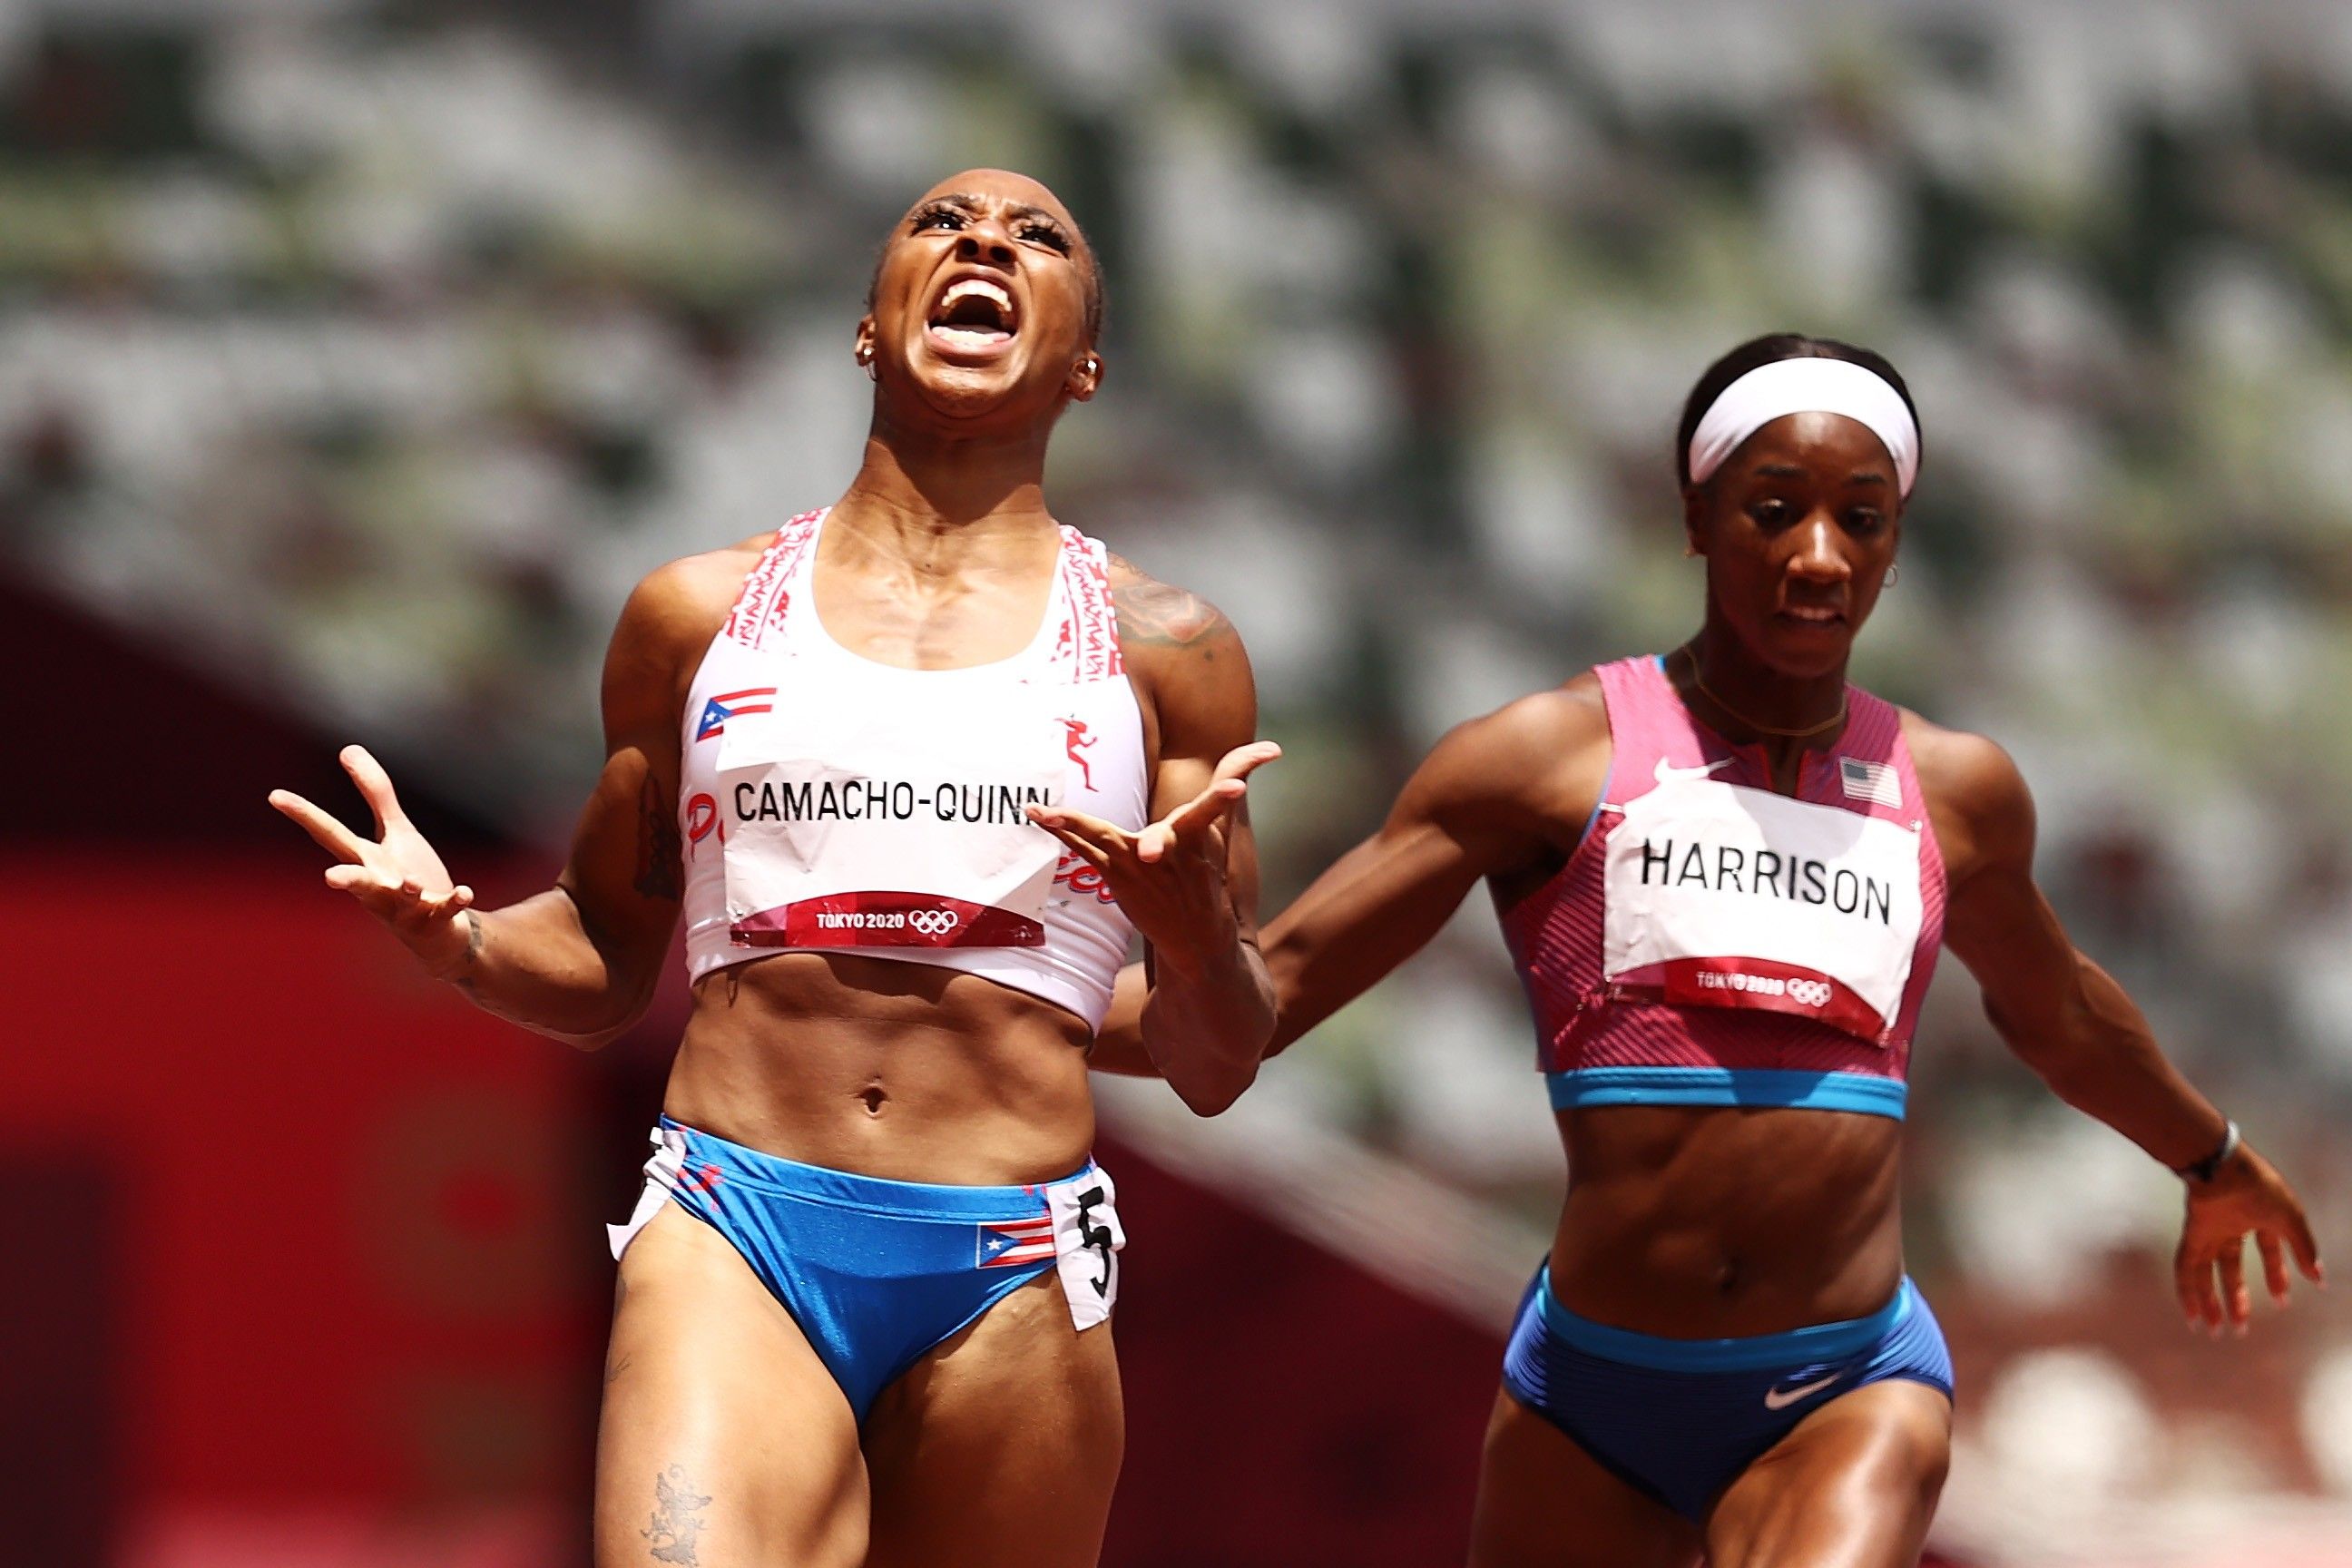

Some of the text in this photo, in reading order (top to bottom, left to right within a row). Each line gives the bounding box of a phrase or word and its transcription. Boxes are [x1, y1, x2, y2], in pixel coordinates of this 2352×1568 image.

[817, 913, 906, 929] TOKYO 2020
[1640, 838, 1891, 926] HARRISON
[1077, 1185, 1112, 1299] 5
